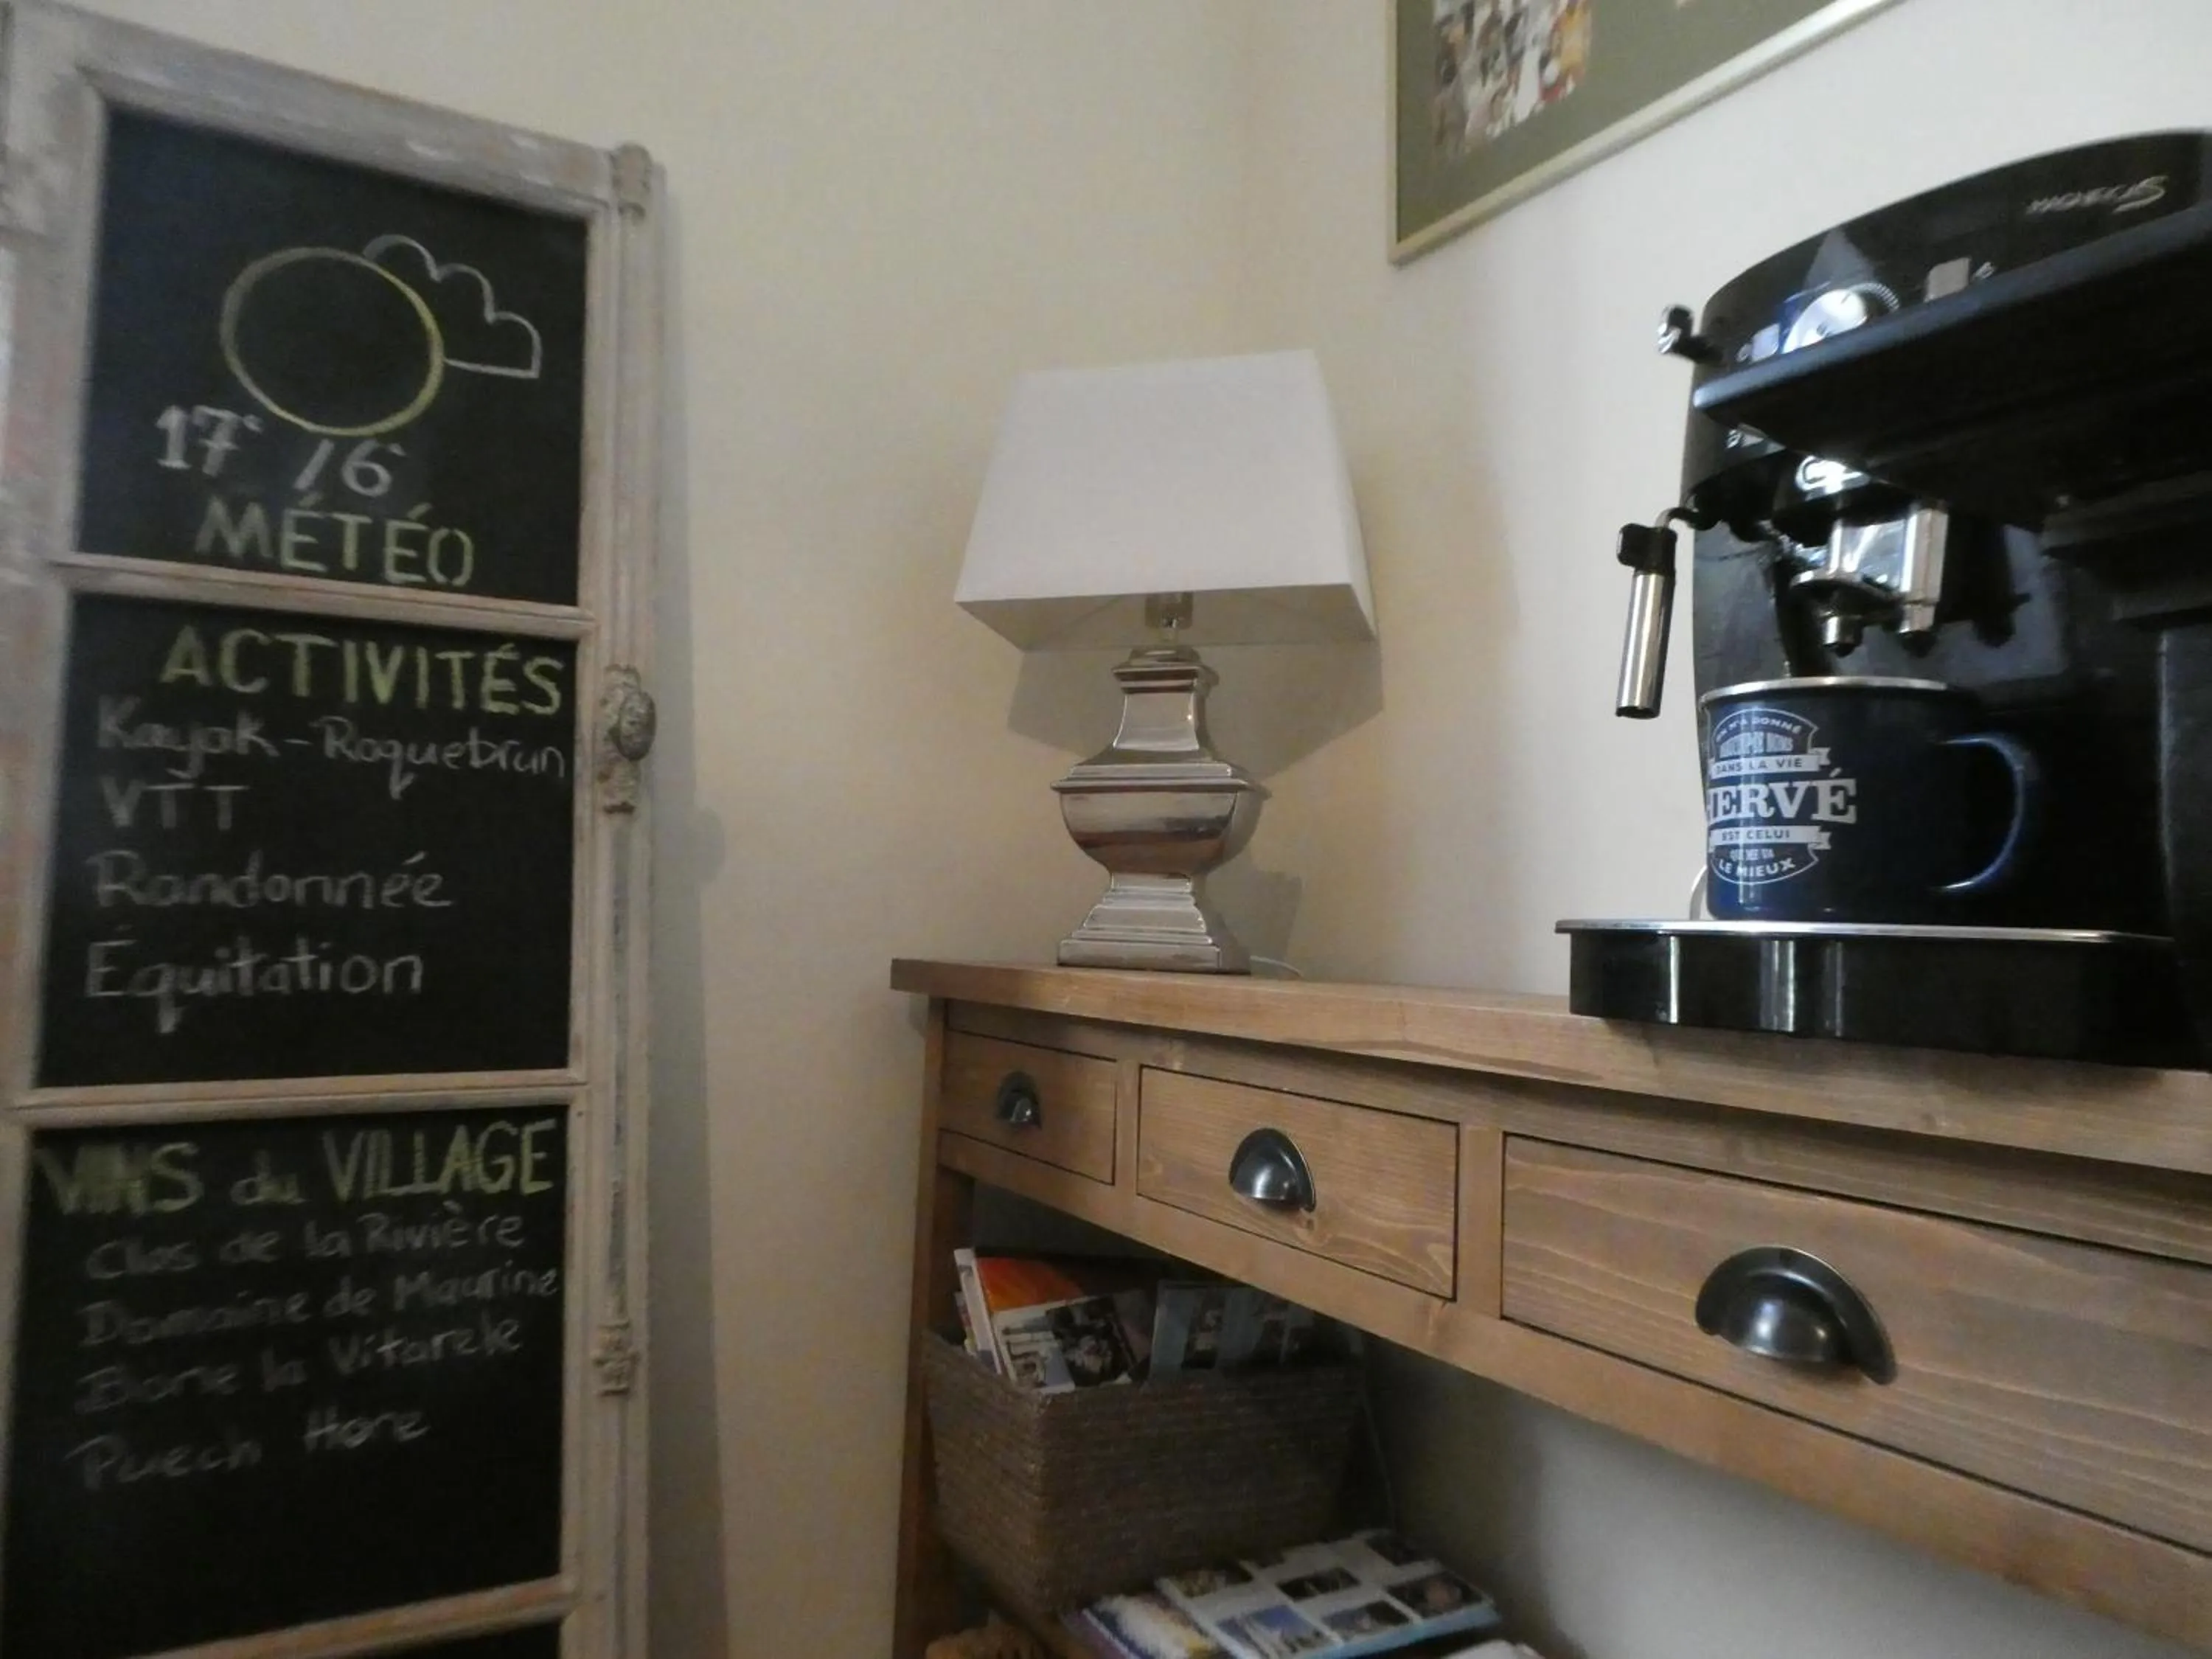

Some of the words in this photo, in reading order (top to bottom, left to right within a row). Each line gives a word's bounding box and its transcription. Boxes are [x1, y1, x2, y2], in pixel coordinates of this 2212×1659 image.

[195, 492, 474, 588] MÉTÉO
[159, 625, 563, 717] ACTIVITÉS
[96, 695, 280, 779] Kayak
[307, 715, 565, 800] Roquebrun
[1749, 760, 1768, 769] LA
[1776, 758, 1803, 768] VIE
[100, 776, 249, 830] VTT
[1747, 830, 1790, 840] CELUI
[85, 849, 454, 908] Randonnée
[1719, 859, 1733, 874] LE
[1736, 858, 1796, 877] MIEUX
[230, 1150, 306, 1205] du
[323, 1119, 557, 1202] VILLAGE
[224, 1230, 280, 1262] de
[304, 1220, 352, 1256] la
[323, 1276, 376, 1318] de
[261, 1346, 308, 1392] la
